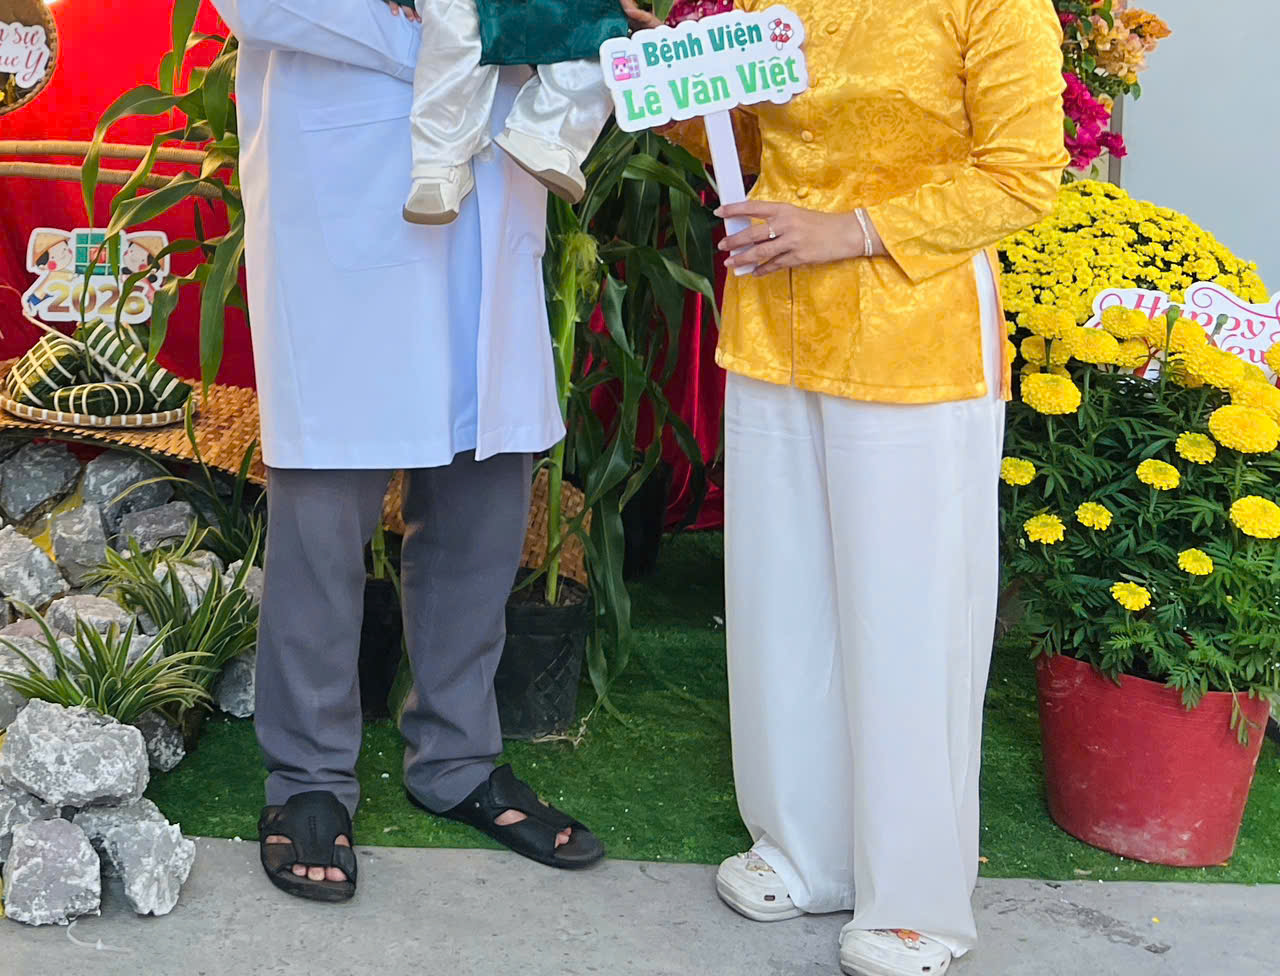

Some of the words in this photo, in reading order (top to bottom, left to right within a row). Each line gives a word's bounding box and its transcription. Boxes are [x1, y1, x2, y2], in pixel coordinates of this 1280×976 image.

[12, 26, 43, 49] sự
[642, 32, 704, 68] Bệnh
[707, 22, 763, 52] Viện
[623, 84, 663, 121] Lê
[668, 72, 731, 111] Văn
[736, 55, 800, 93] Việt
[47, 282, 147, 315] 2026
